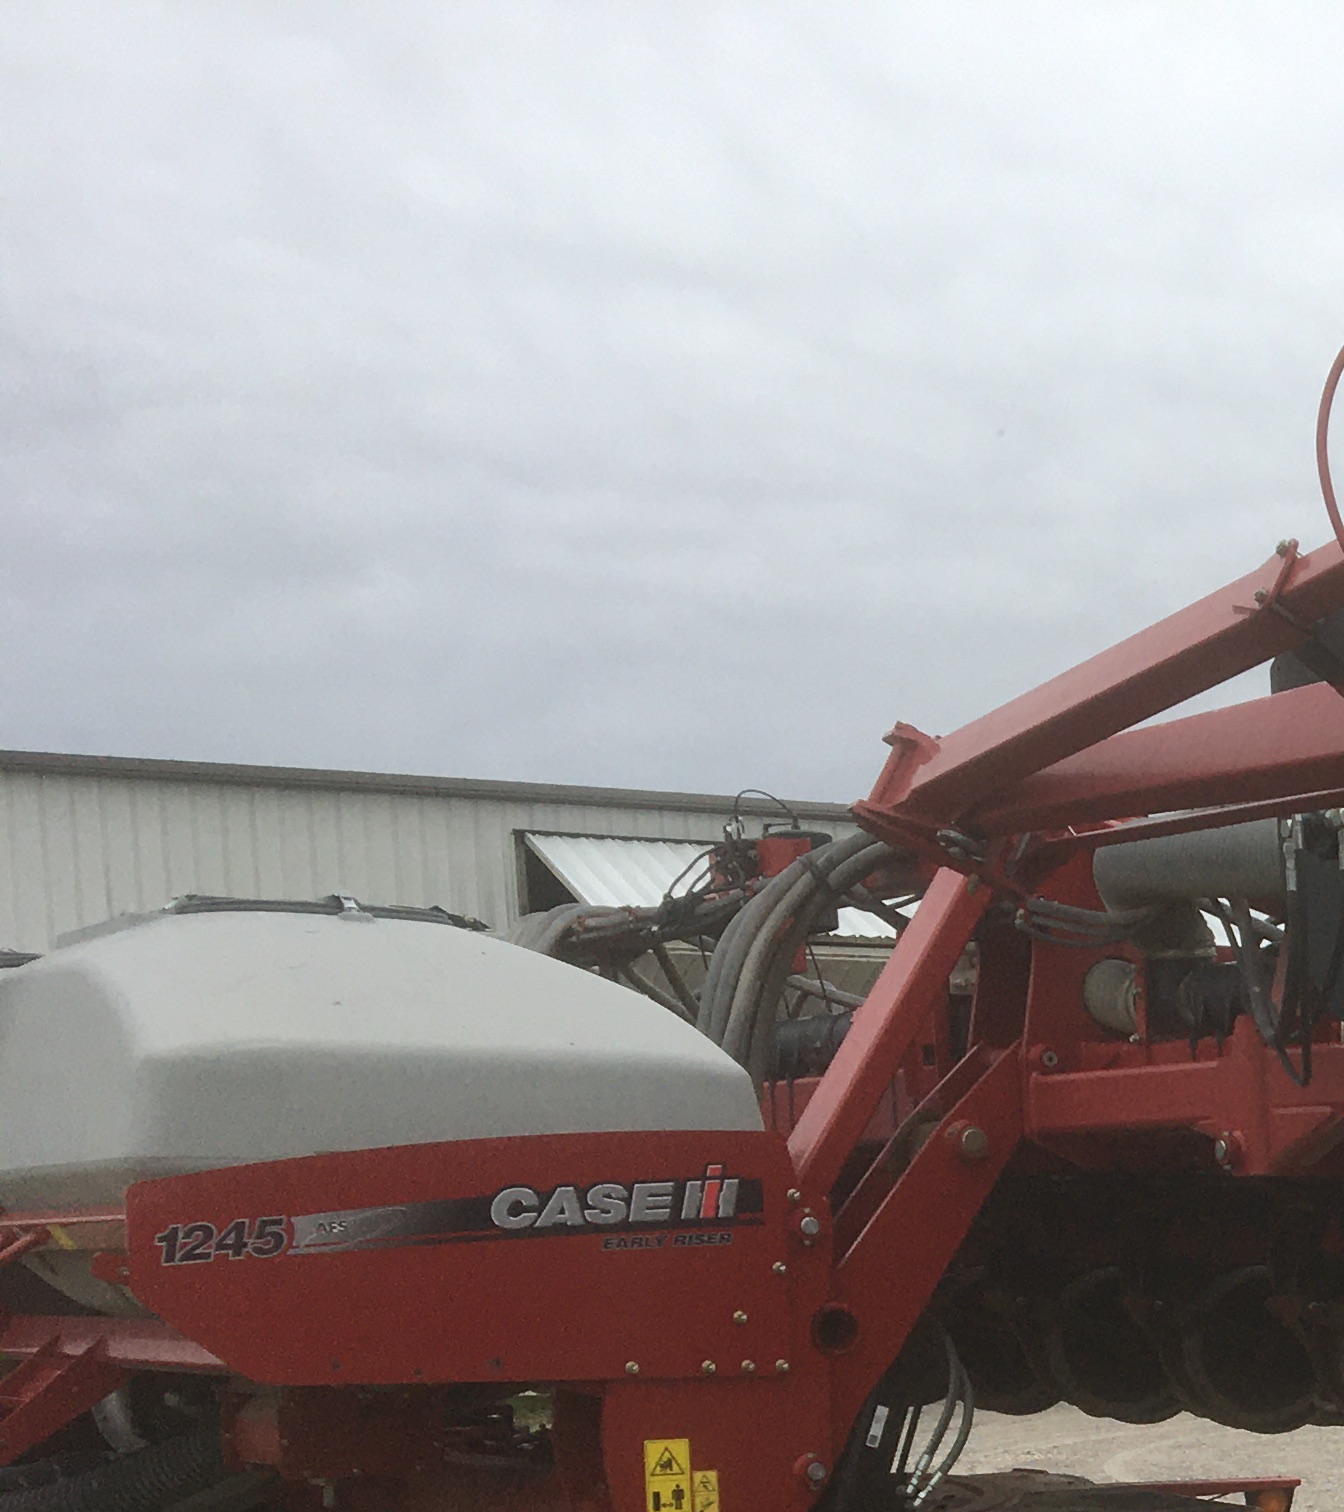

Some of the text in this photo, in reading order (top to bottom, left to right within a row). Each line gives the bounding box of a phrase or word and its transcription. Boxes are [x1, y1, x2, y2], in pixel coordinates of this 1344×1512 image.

[490, 1181, 675, 1229] CASE
[154, 1215, 287, 1266] 1245
[602, 1232, 733, 1251] EARLY RISER
